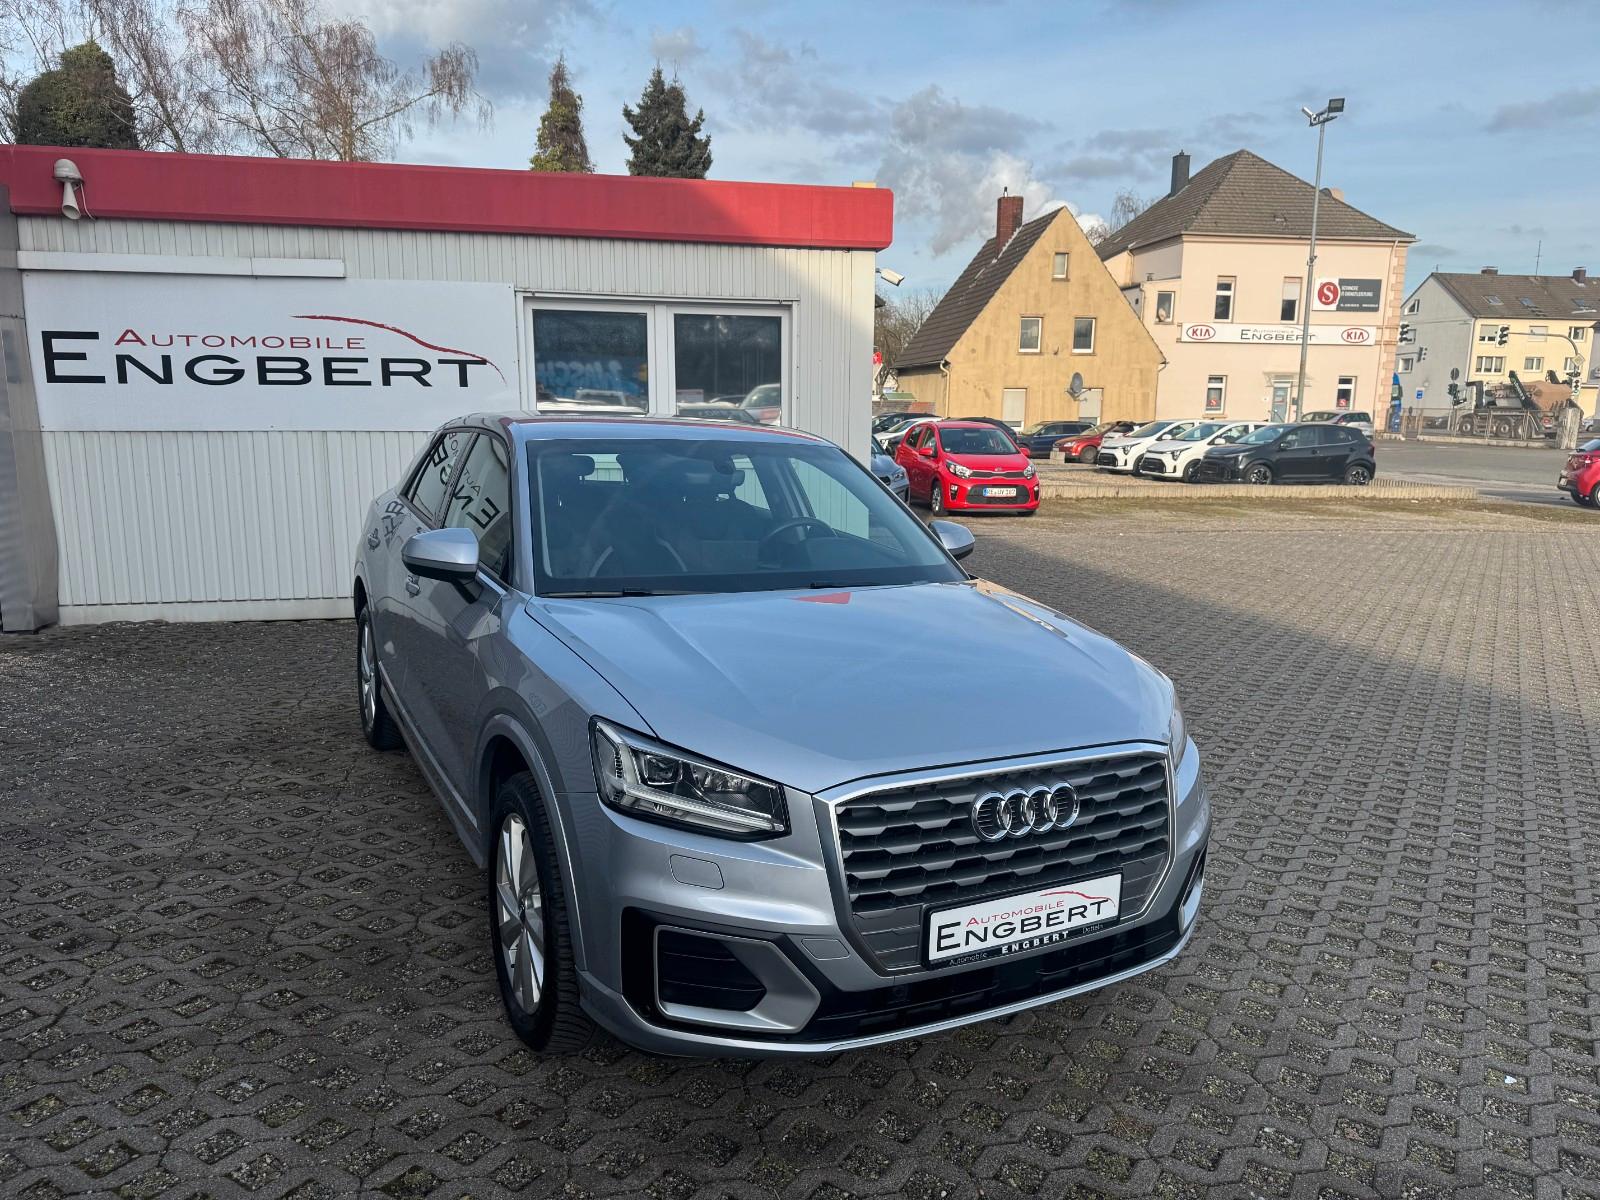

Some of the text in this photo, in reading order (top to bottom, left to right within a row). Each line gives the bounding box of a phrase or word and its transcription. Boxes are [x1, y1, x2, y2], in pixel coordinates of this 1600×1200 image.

[114, 328, 367, 350] AUTOMOBILE
[1192, 327, 1210, 337] KIA
[1346, 331, 1365, 340] KIA
[41, 330, 488, 388] ENGBERT
[936, 898, 1109, 952] ENGBERT
[966, 900, 1065, 927] AUTOMOBILE
[1001, 930, 1069, 955] ENGBERT
